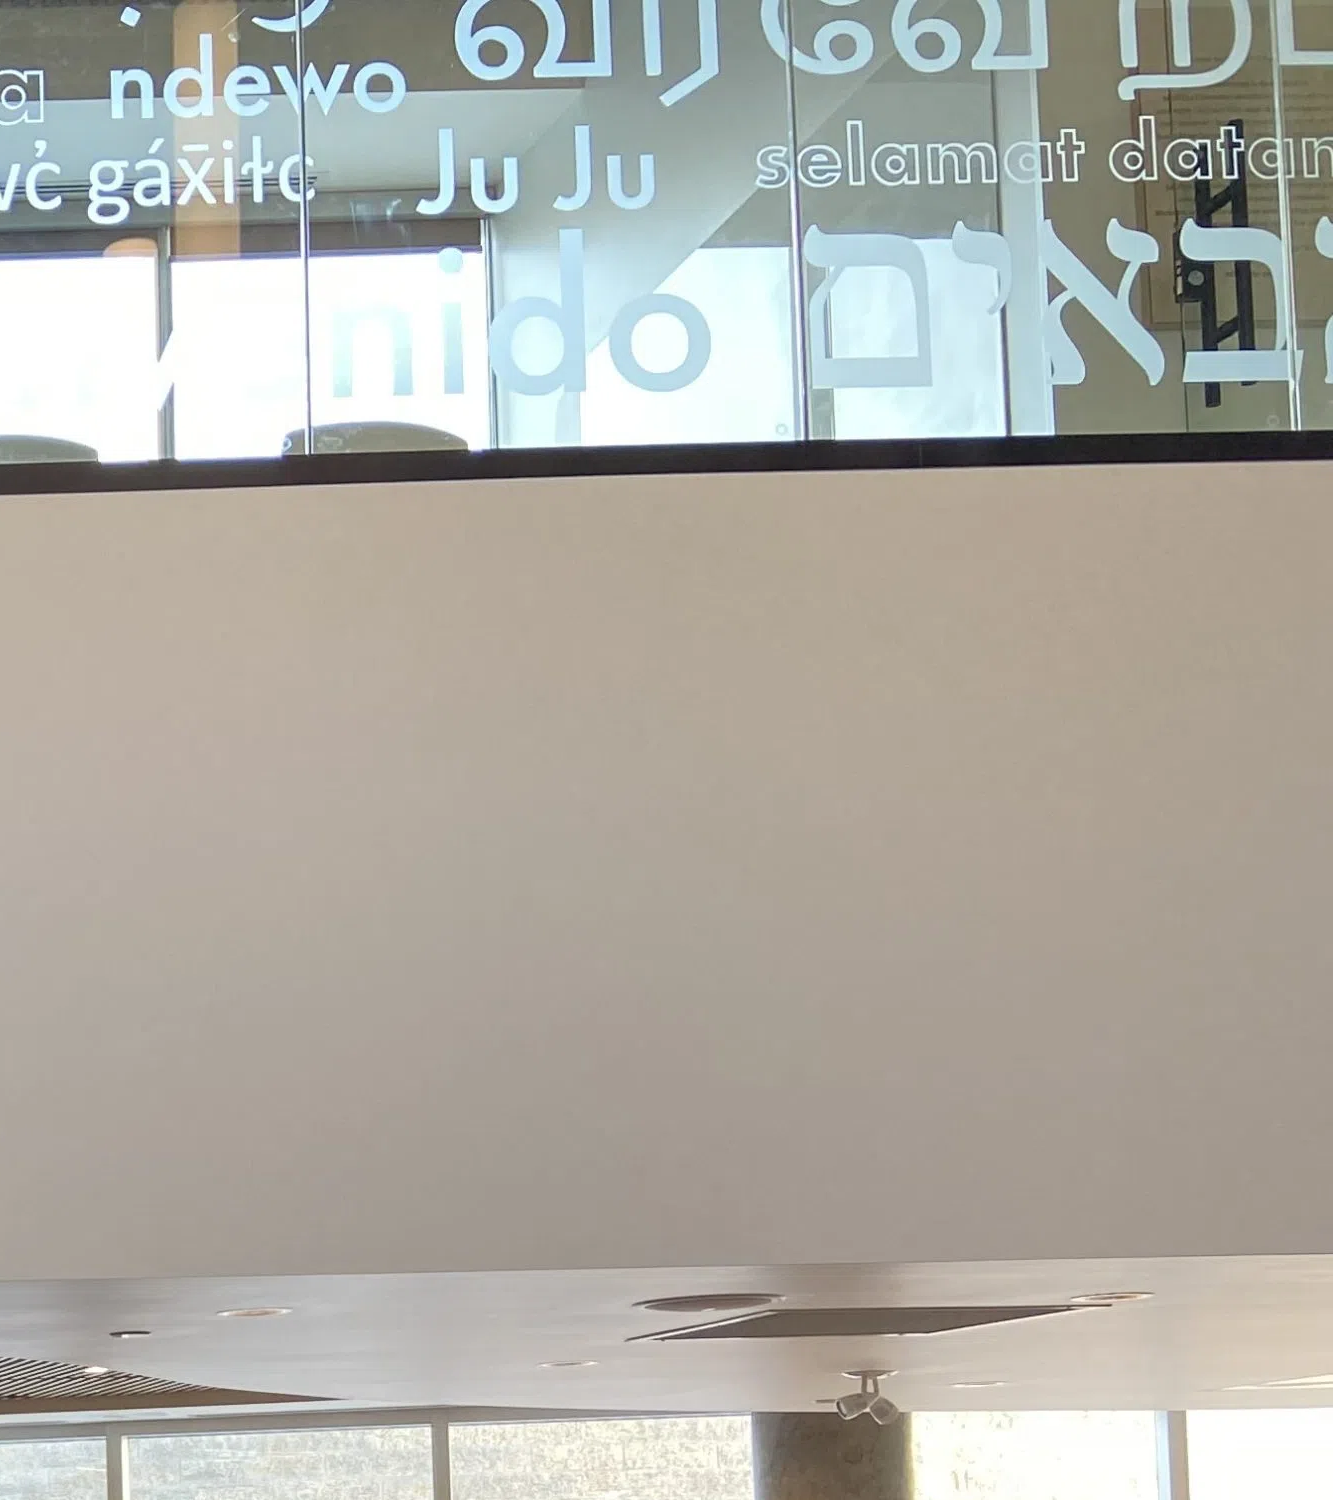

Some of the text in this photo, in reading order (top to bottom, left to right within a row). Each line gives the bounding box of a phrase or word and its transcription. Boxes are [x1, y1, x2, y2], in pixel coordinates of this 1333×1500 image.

[110, 34, 407, 119] ndewo
[416, 124, 656, 216] Ju Ju
[755, 119, 1086, 189] selamat
